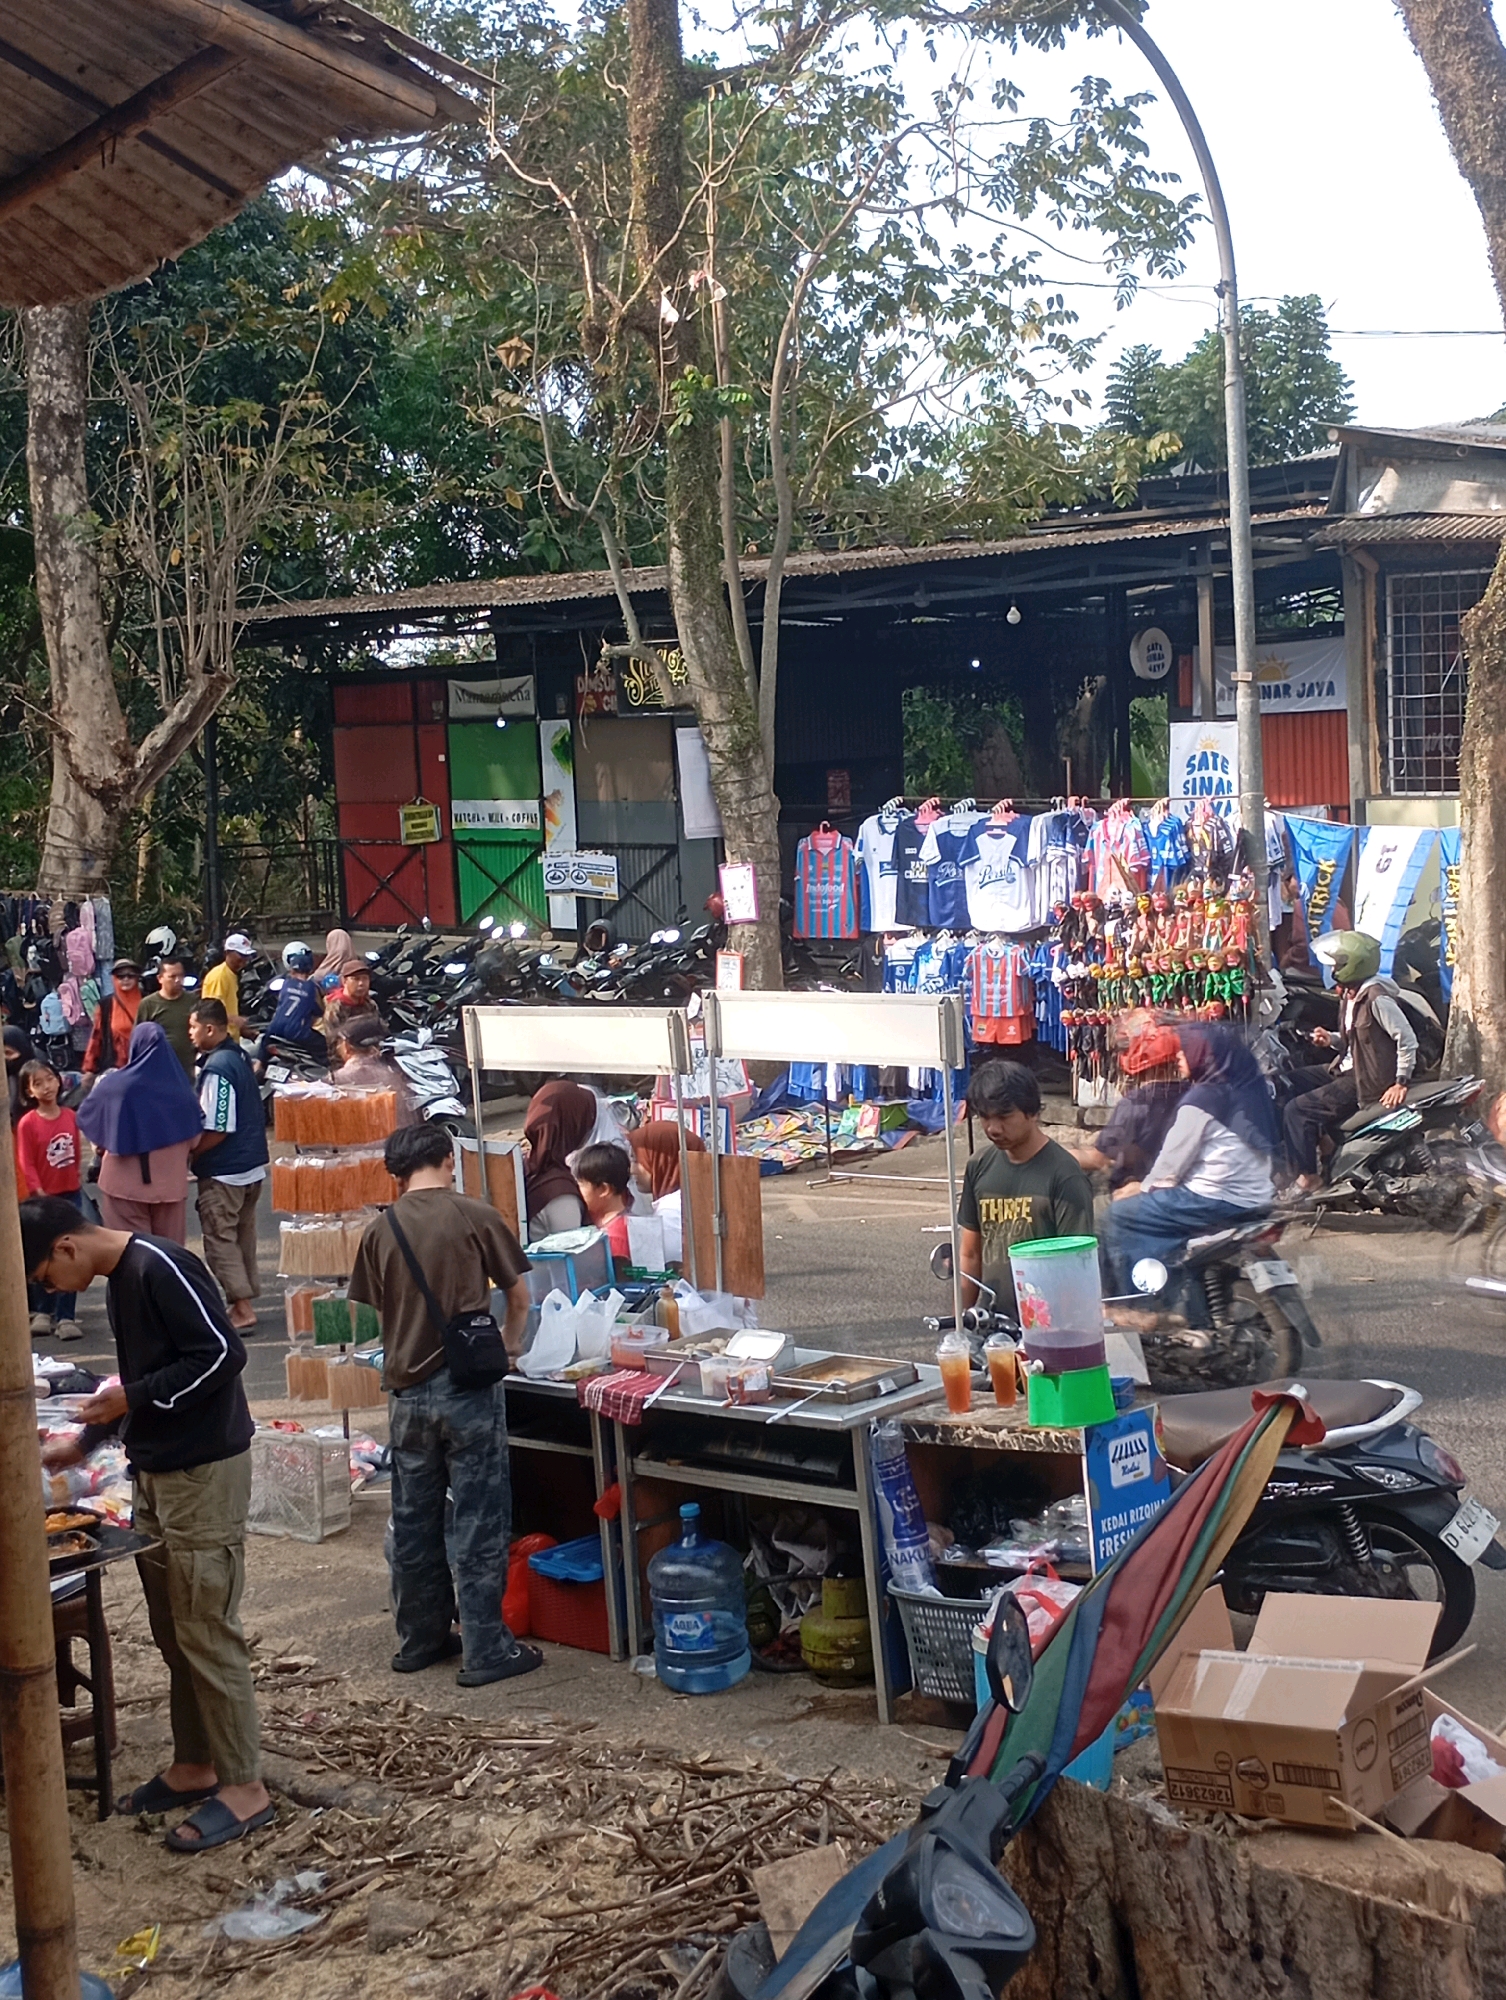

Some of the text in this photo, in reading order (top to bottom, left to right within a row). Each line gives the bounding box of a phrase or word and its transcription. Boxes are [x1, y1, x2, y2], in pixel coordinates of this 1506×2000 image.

[1296, 681, 1335, 699] JAYA
[1186, 751, 1229, 775] SATE
[1183, 776, 1232, 796] SINAR
[1184, 800, 1232, 818] JYA
[806, 882, 845, 895] Indofood
[285, 995, 301, 1016] 7
[980, 1197, 1032, 1223] THREE
[1101, 1512, 1128, 1534] KEDAI
[1444, 1533, 1459, 1548] D
[673, 1620, 700, 1631] AQUA
